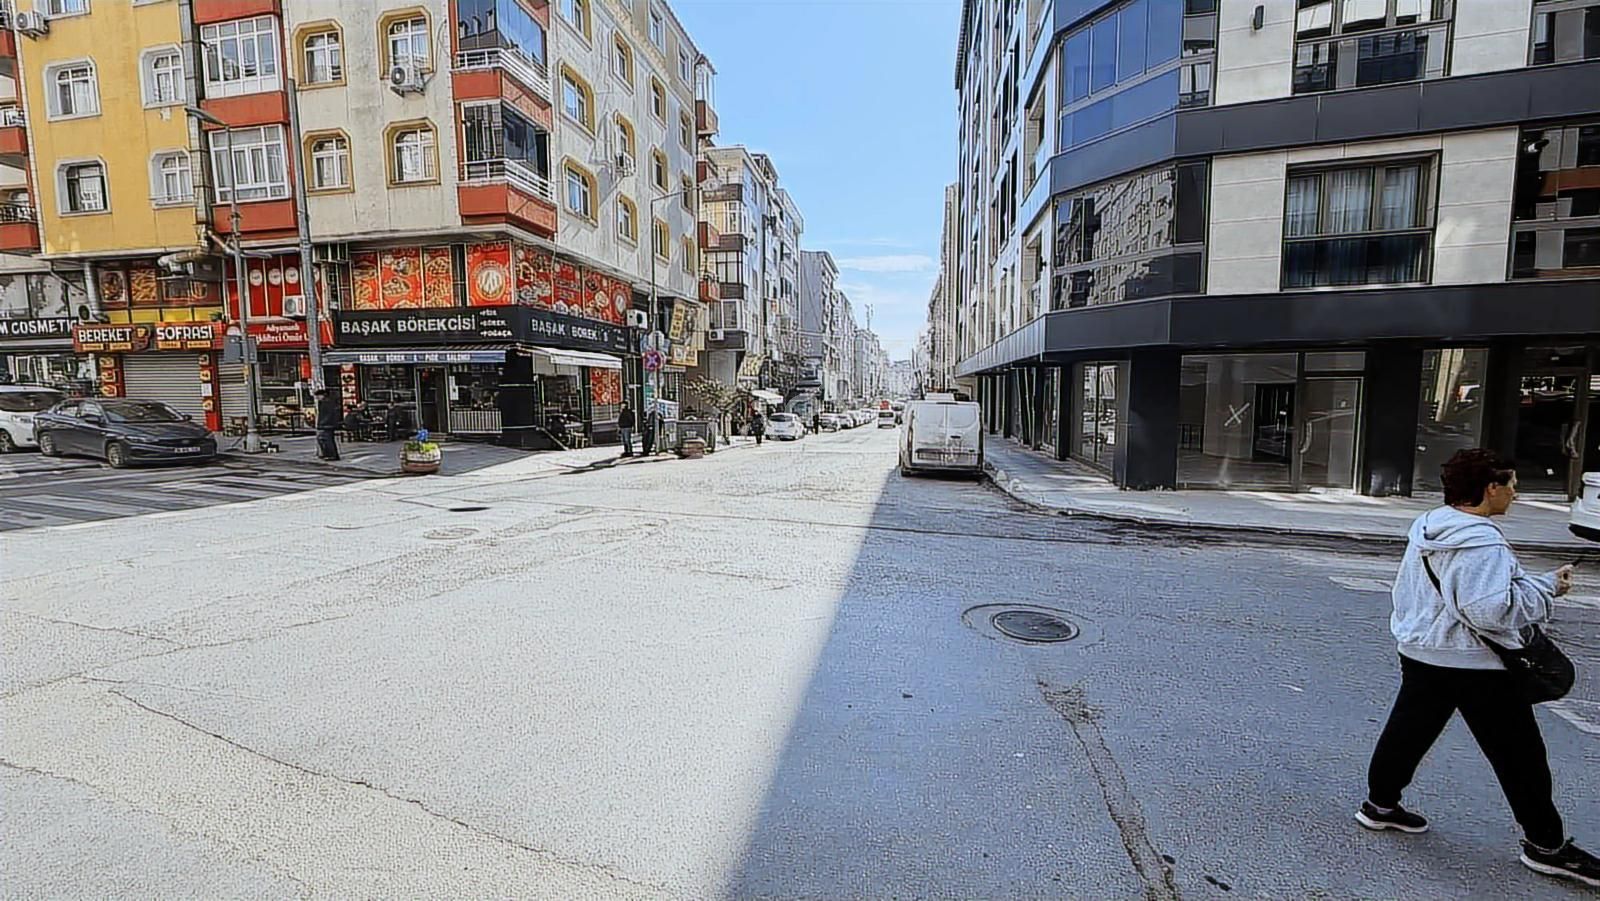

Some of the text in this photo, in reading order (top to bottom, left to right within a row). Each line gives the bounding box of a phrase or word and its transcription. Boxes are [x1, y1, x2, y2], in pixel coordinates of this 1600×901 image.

[78, 325, 213, 342] BEREKET SOFRASI
[341, 320, 392, 336] BAŞAK
[531, 318, 566, 337] BAŞAK
